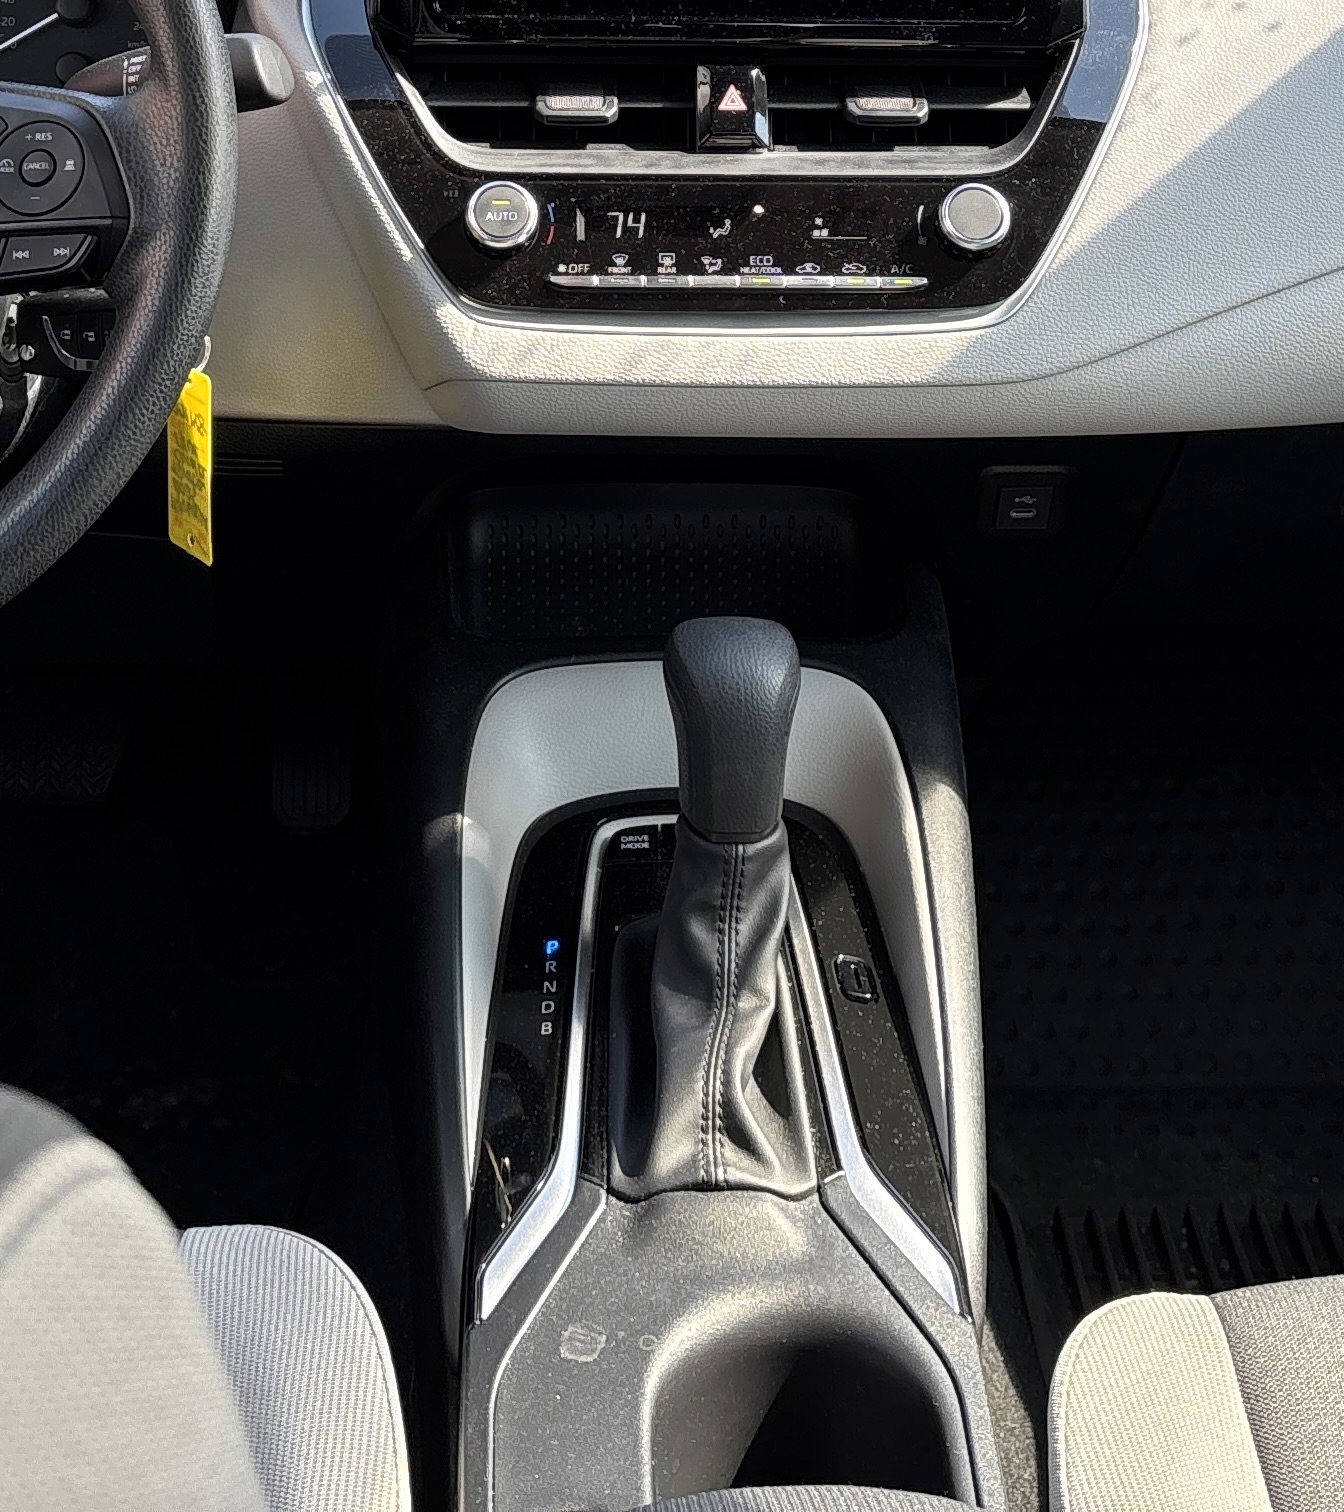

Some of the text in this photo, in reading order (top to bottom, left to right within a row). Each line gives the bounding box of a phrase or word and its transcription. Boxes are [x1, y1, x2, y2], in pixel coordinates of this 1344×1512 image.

[1, 17, 16, 26] 20
[128, 65, 142, 73] OFF
[35, 132, 53, 141] RES
[23, 161, 50, 170] CANCEL
[485, 211, 518, 221] AUTO
[607, 211, 646, 238] 74
[750, 255, 774, 266] ECO
[568, 263, 591, 274] OFF
[607, 266, 633, 274] FRONT
[657, 266, 677, 274] REAR
[740, 266, 784, 274] HEAT/COOL
[890, 264, 914, 274] A/C
[620, 834, 649, 842] DRIVE
[546, 940, 559, 954] P
[545, 961, 556, 973] R
[543, 980, 557, 993] N
[541, 1001, 555, 1014] D
[541, 1021, 553, 1035] B
